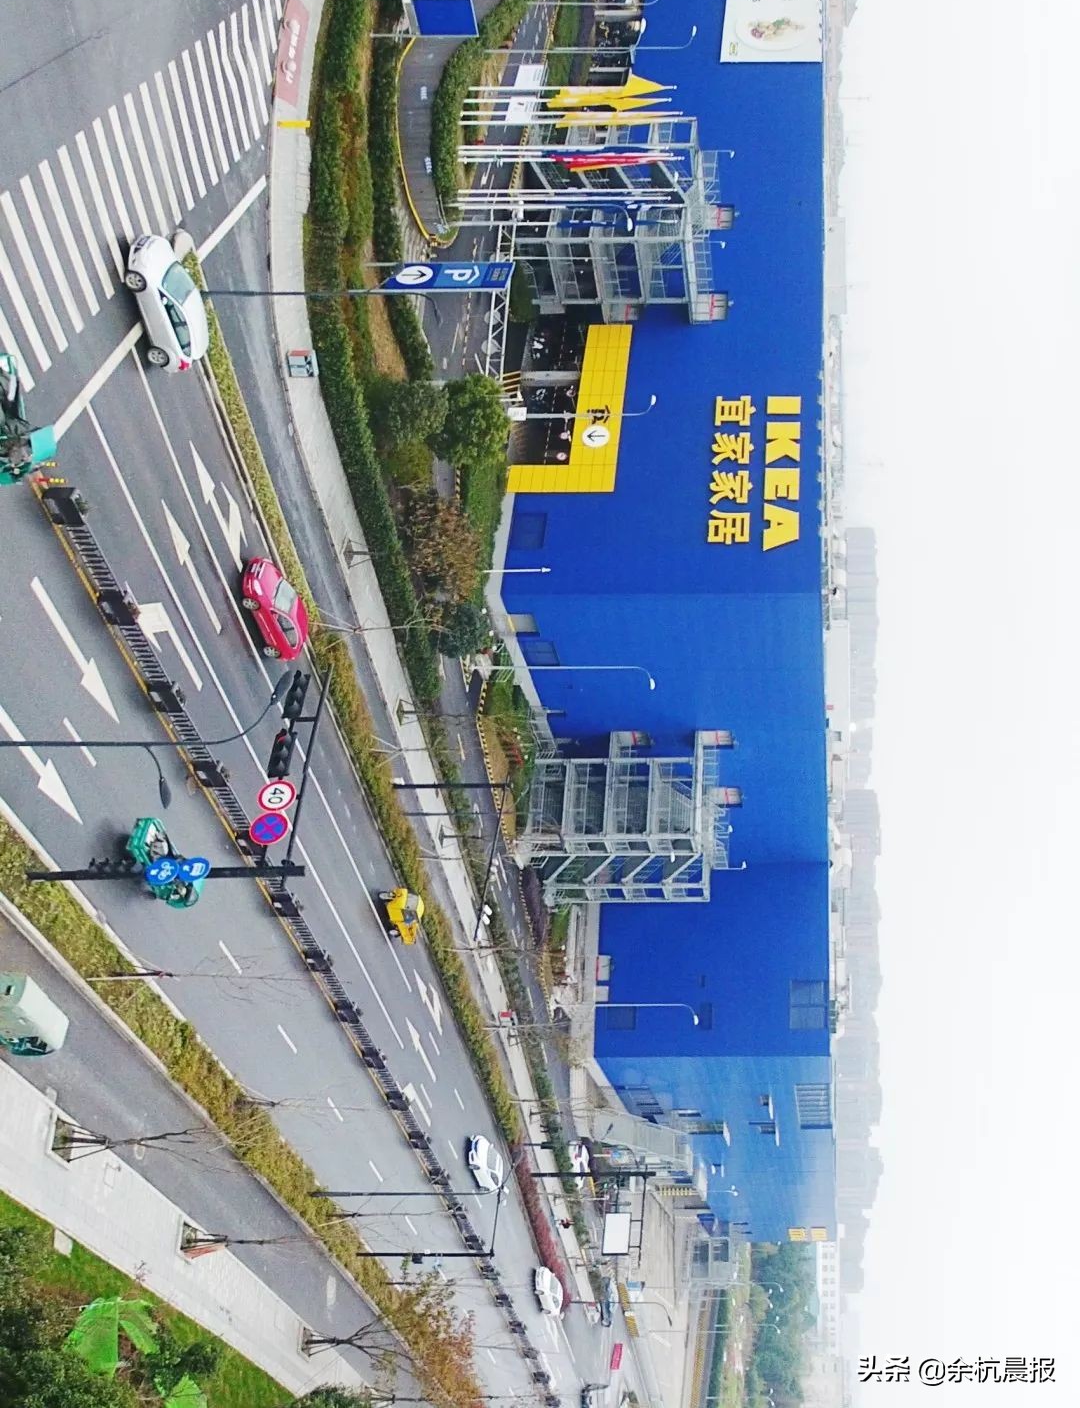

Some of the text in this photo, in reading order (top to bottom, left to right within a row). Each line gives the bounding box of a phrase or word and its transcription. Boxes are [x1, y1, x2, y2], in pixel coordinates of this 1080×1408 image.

[444, 269, 472, 281] P
[708, 395, 756, 545] 宜家家居
[762, 396, 801, 551] IKEA
[267, 787, 285, 804] 40
